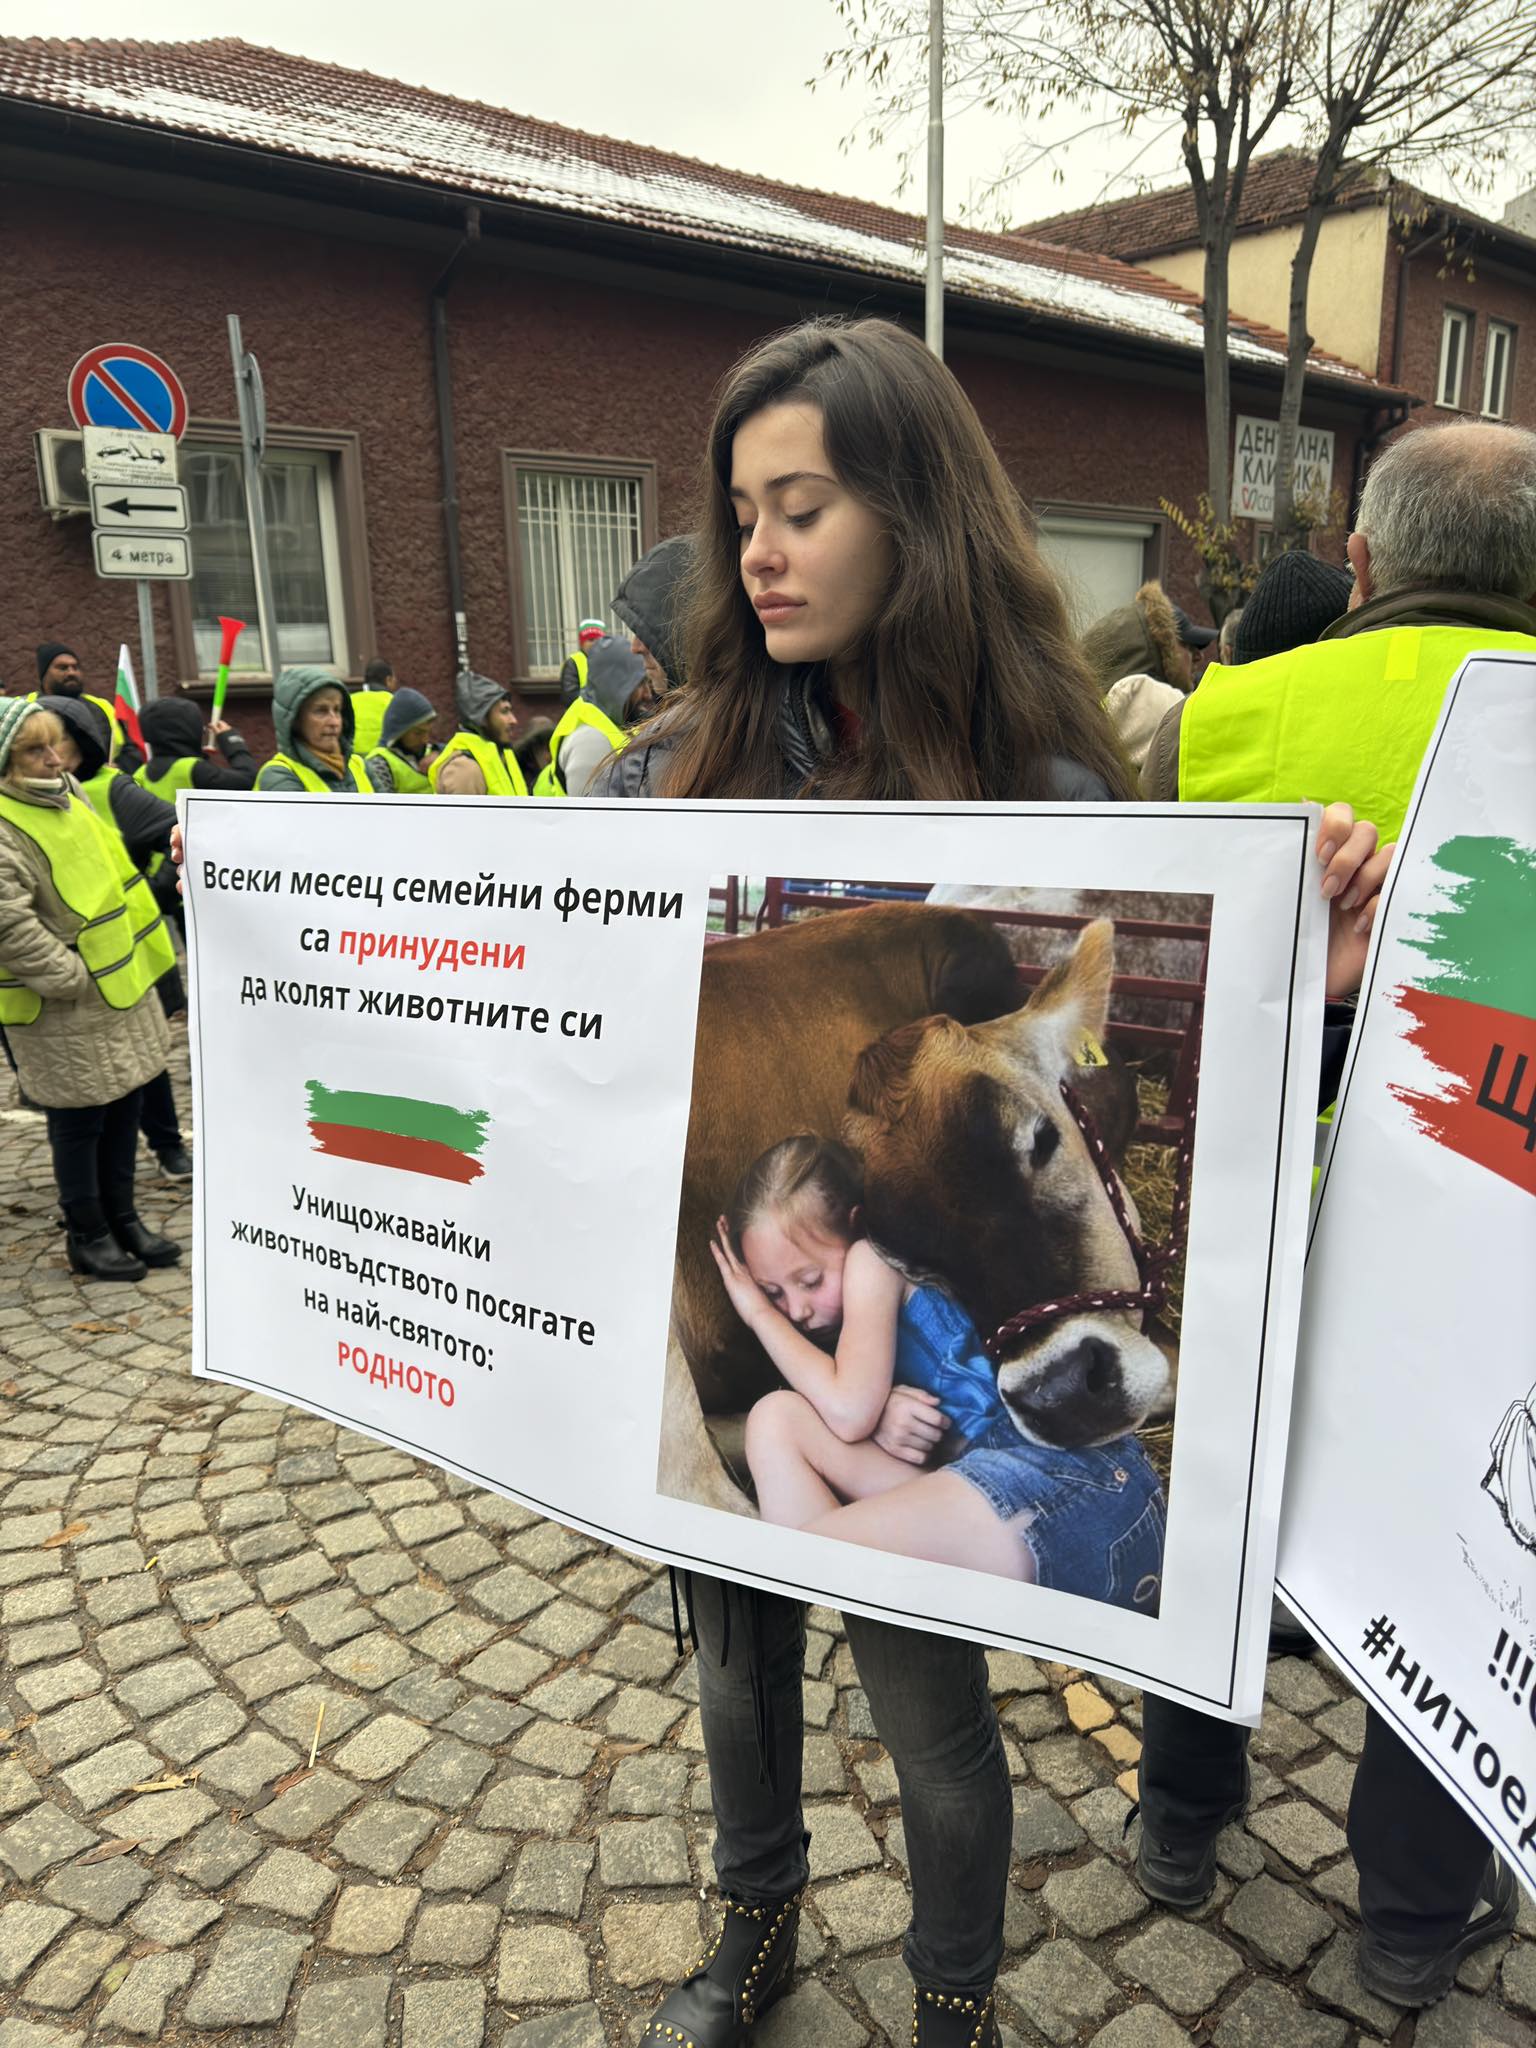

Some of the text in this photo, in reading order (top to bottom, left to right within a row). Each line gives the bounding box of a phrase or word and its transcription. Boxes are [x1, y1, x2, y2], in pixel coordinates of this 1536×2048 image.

[1239, 423, 1330, 464] ДЕНЛНА
[111, 549, 174, 566] 4 метра
[203, 860, 684, 926] Всеки месец семейни ферми
[300, 927, 526, 973] са принудени
[240, 975, 603, 1040] да колят животните си
[292, 1184, 491, 1263] Унищожавайки
[231, 1220, 596, 1346] животновъдството посягате
[304, 1287, 494, 1372] на най-святото:
[338, 1341, 456, 1408] РОДНОТО
